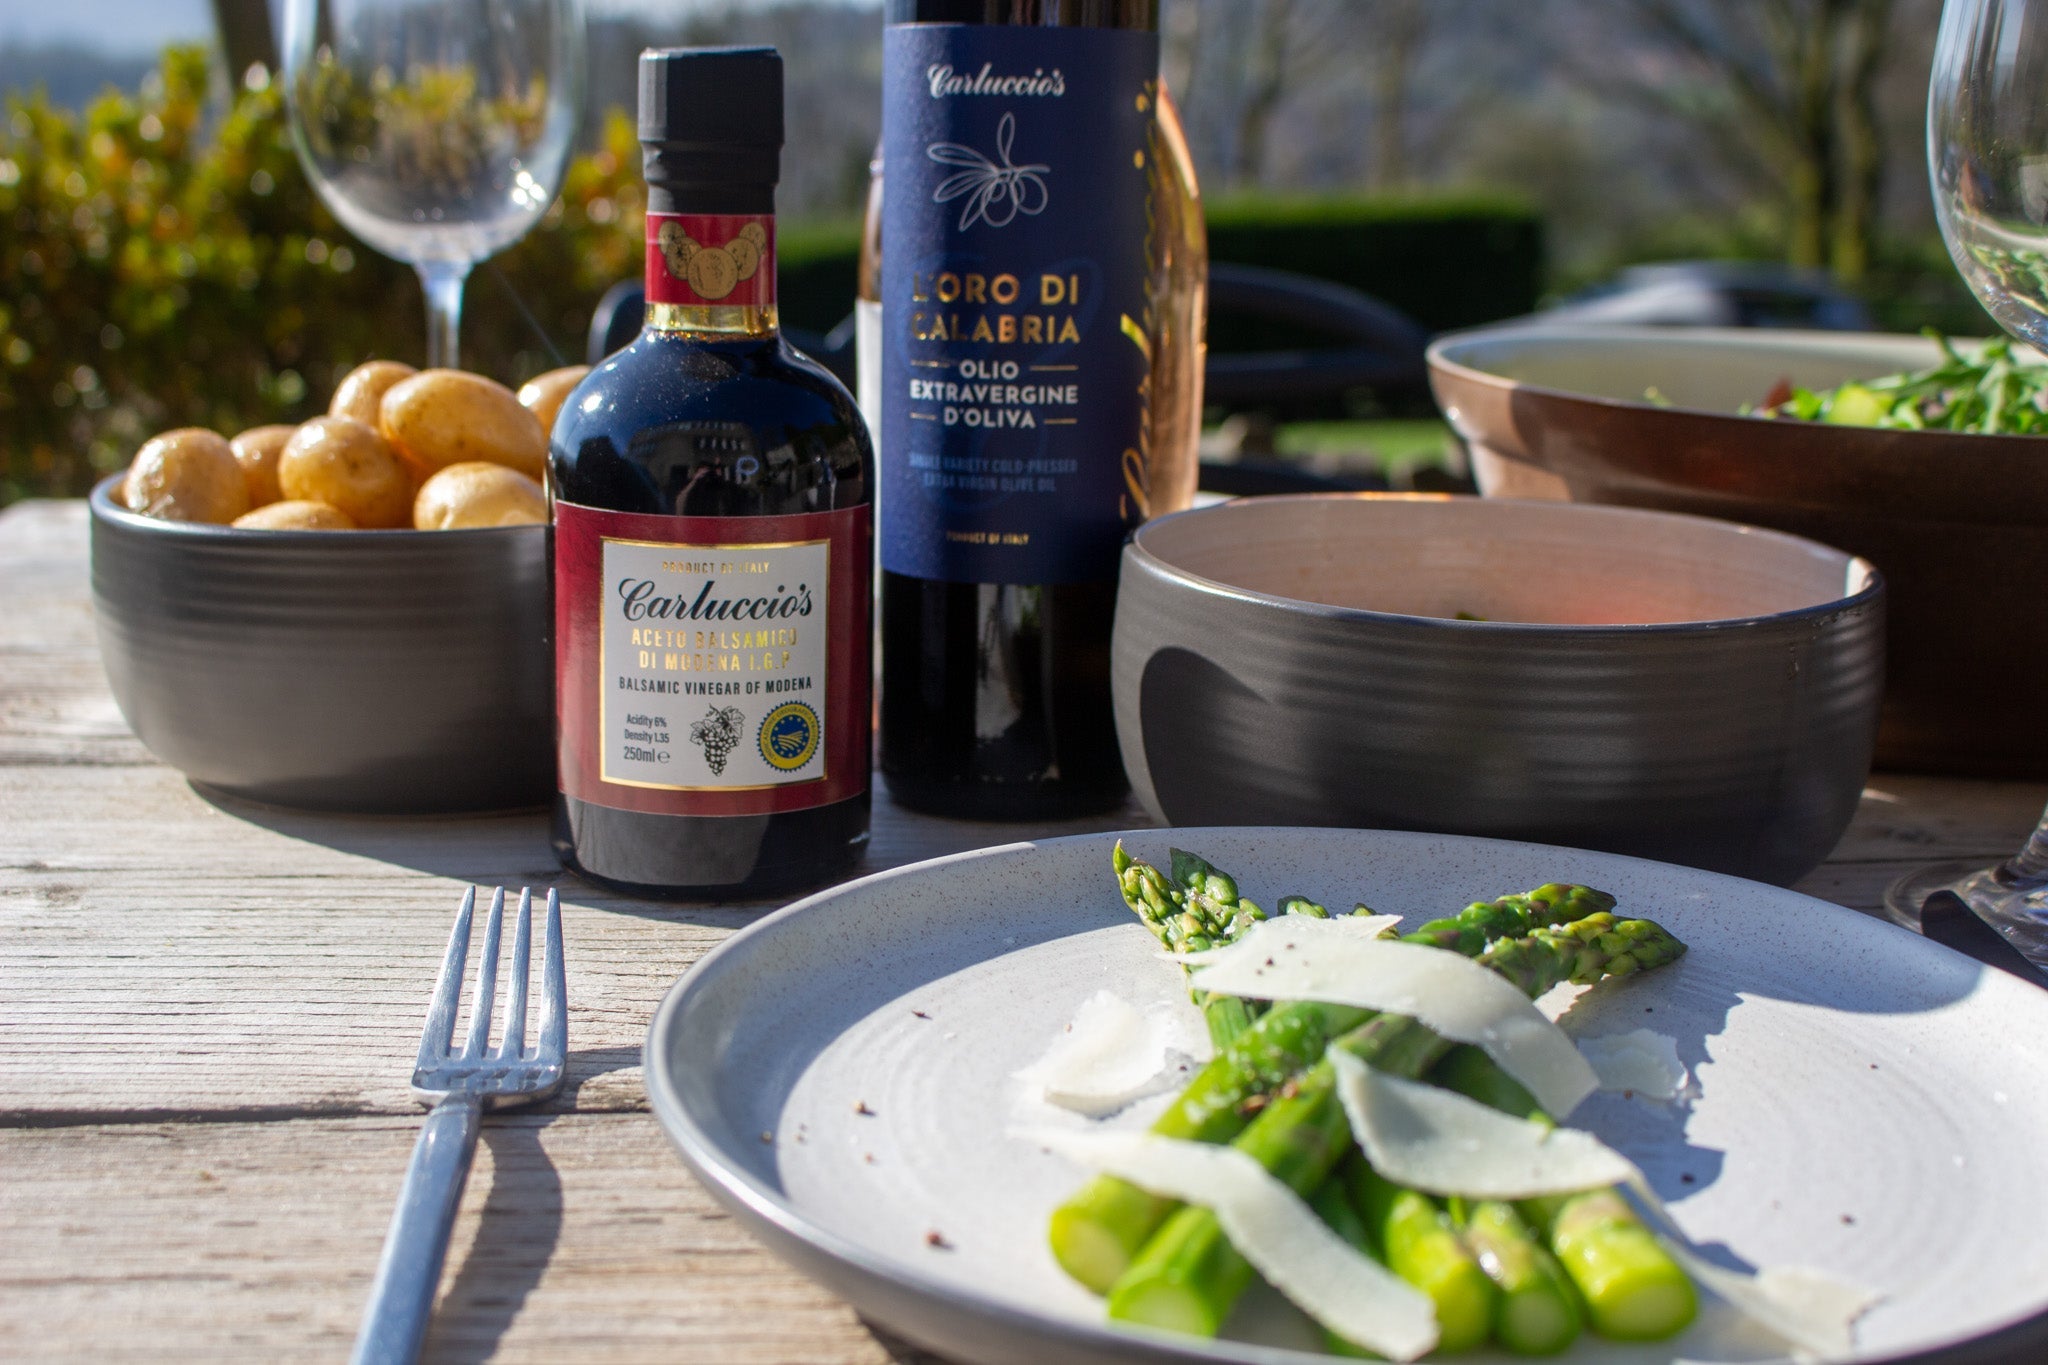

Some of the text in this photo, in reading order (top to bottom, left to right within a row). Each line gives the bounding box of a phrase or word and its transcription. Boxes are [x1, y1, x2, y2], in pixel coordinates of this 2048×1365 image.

[928, 62, 1065, 98] Carluccio's
[913, 272, 1079, 305] L'ORO DI
[911, 311, 1081, 344] CALABRIA
[959, 359, 1019, 380] OLIO
[909, 379, 1078, 405] EXTRAVERGINE
[944, 406, 1036, 429] D'OLIVA
[662, 561, 770, 575] PRODUCT OF ITALY
[618, 577, 812, 622] Carluccio's
[631, 627, 798, 650] ACETO BALSAMICO
[639, 650, 656, 669] DI
[665, 652, 741, 672] MODENA
[619, 676, 812, 696] BALSAMIC VINEGAR OF MODENA
[626, 714, 668, 729] Acidity 6%
[624, 729, 653, 745] Density
[624, 746, 656, 763] 250ml
